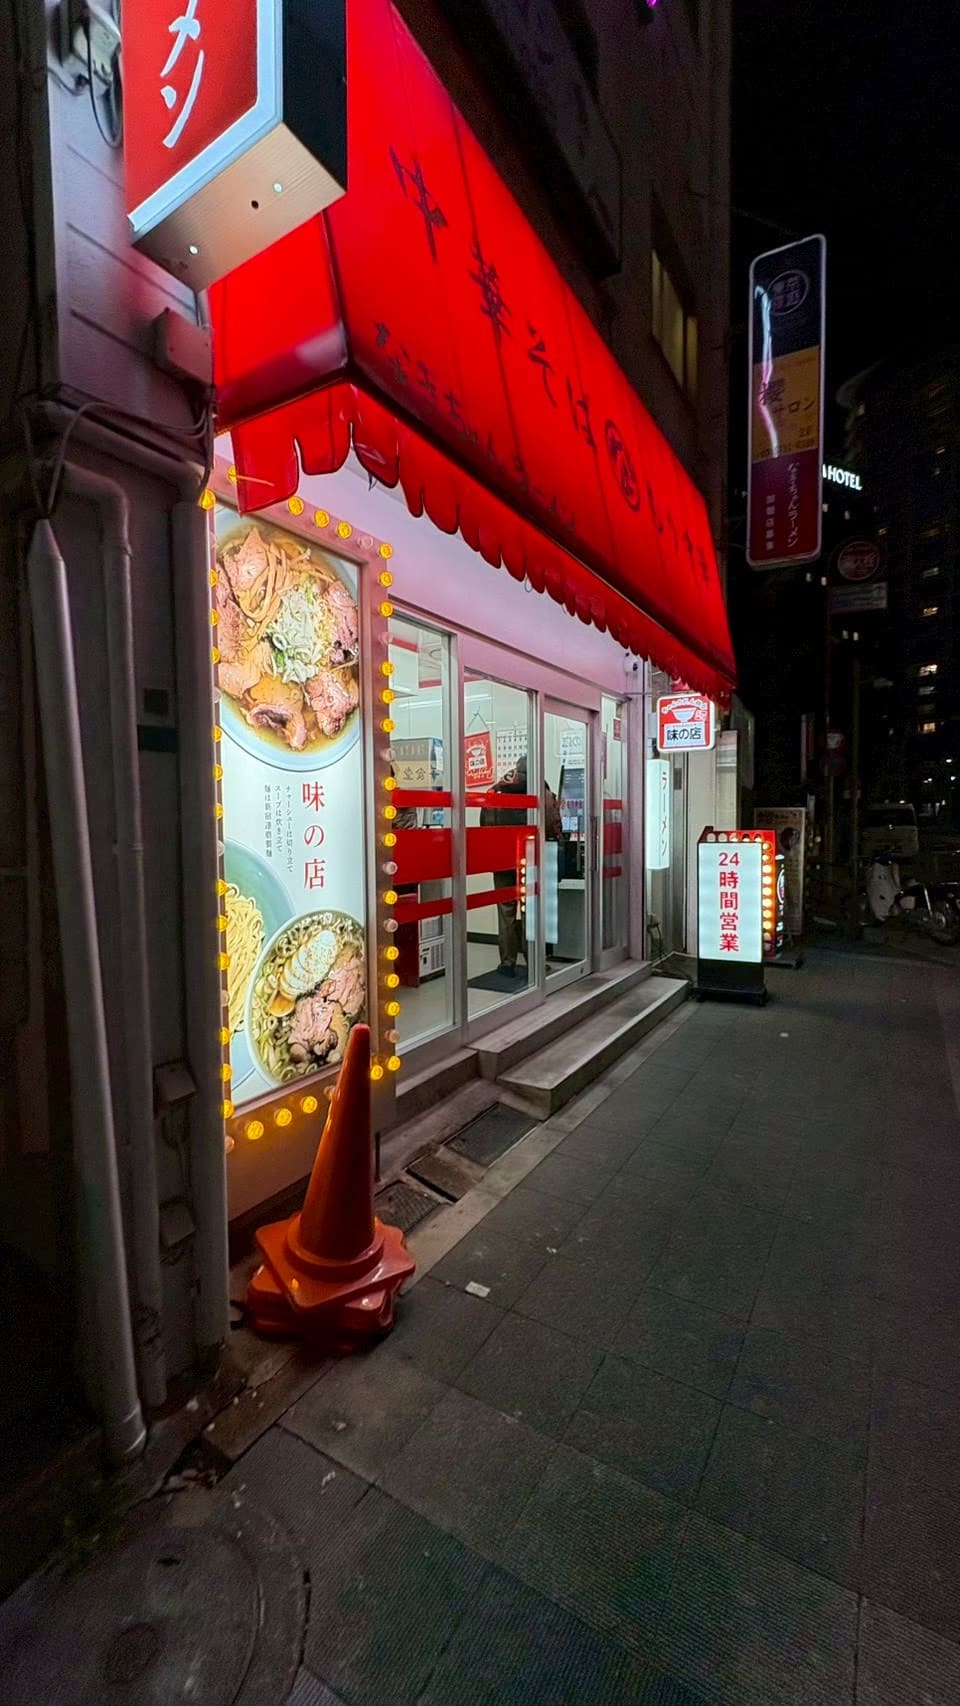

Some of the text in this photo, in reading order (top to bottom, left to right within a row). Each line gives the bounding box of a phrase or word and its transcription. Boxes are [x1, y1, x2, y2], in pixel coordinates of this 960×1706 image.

[827, 464, 863, 491] HOTEL
[666, 727, 702, 742] 味の店
[302, 781, 326, 889] 味の店
[718, 852, 740, 952] 24時間営業
